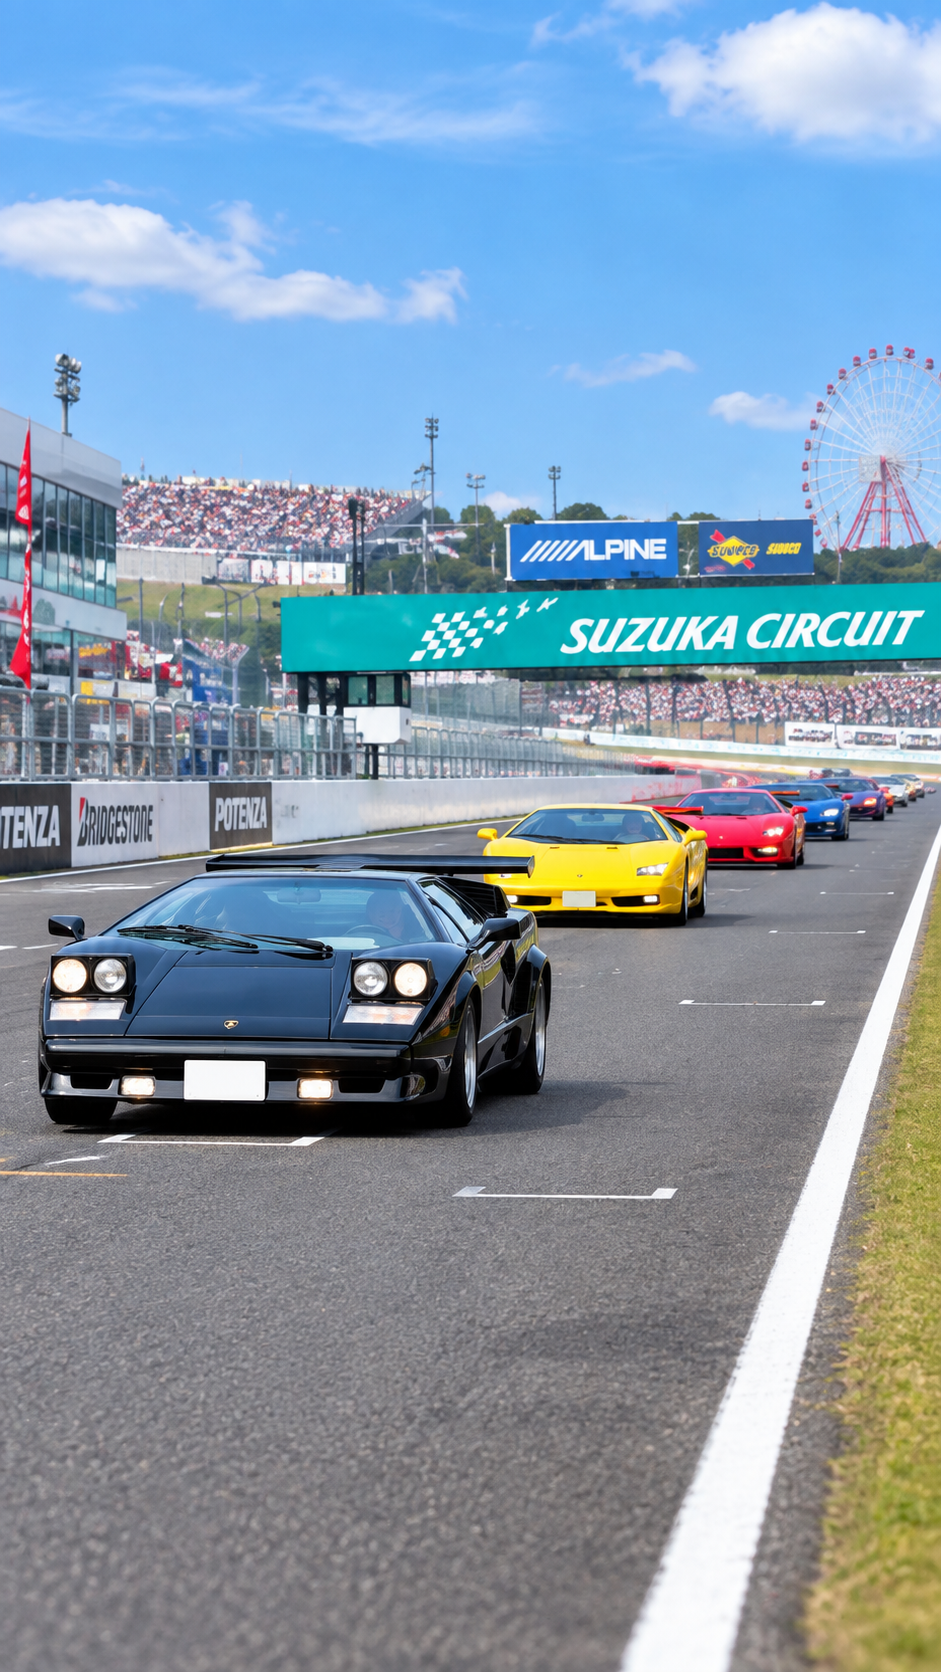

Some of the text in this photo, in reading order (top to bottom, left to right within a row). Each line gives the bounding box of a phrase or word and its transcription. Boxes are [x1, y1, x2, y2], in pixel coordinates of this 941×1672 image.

[565, 538, 667, 562] ALPINE
[560, 609, 925, 655] SUZUKA CIRCUIT
[0, 805, 61, 849] TENZA
[76, 796, 154, 847] BRIDGESTONE
[214, 796, 268, 832] POTENZA
